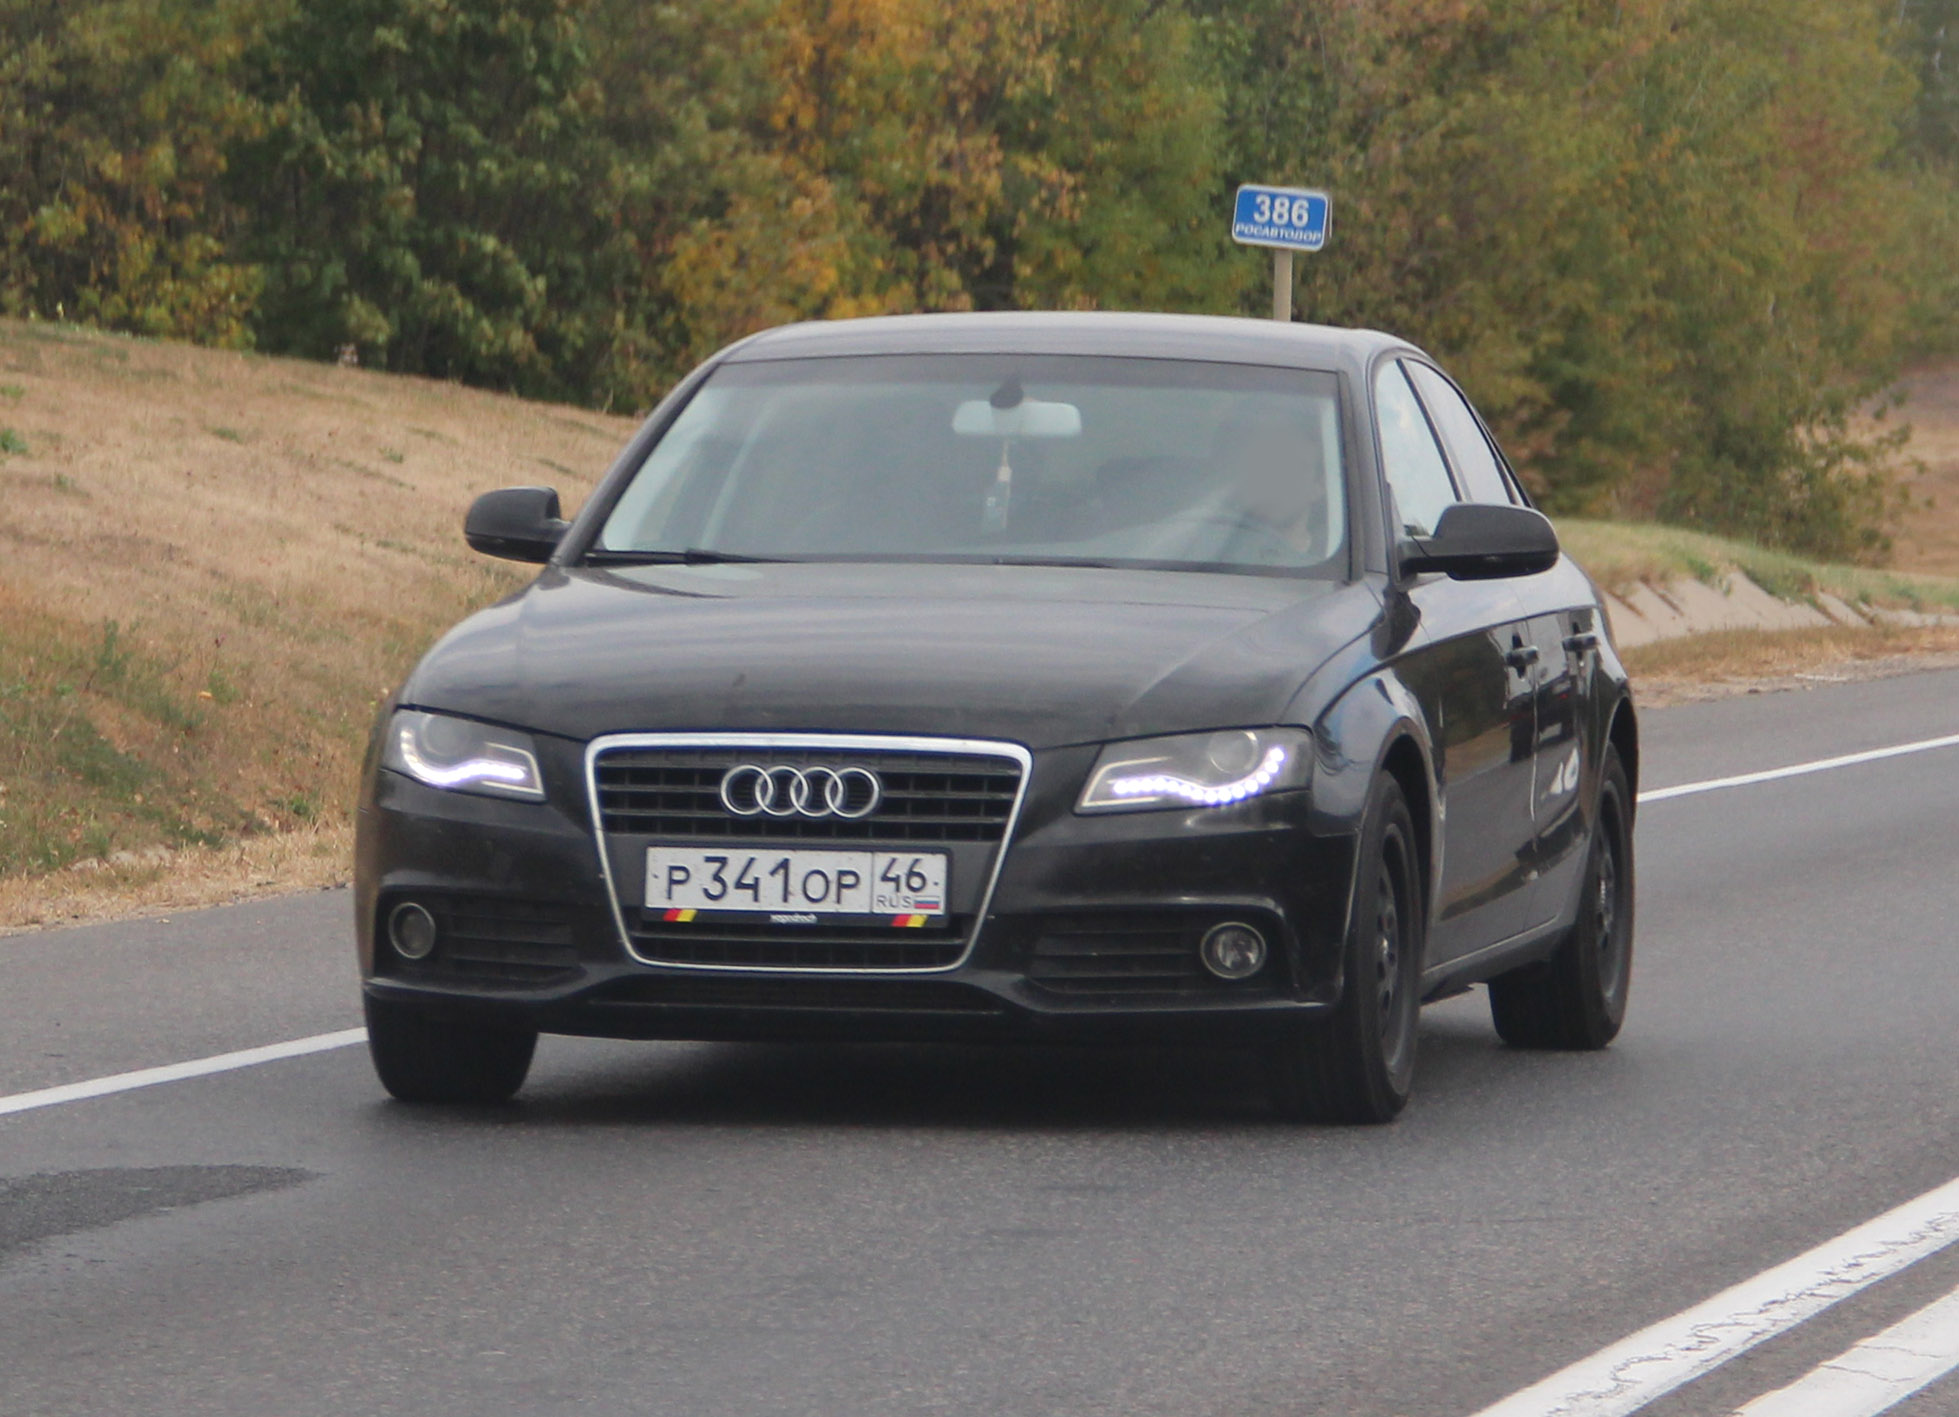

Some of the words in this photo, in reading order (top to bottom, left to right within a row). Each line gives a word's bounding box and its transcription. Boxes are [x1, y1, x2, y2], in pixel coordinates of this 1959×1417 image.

[1253, 194, 1310, 228] 386
[880, 857, 927, 893] 46
[877, 895, 912, 908] RUS
